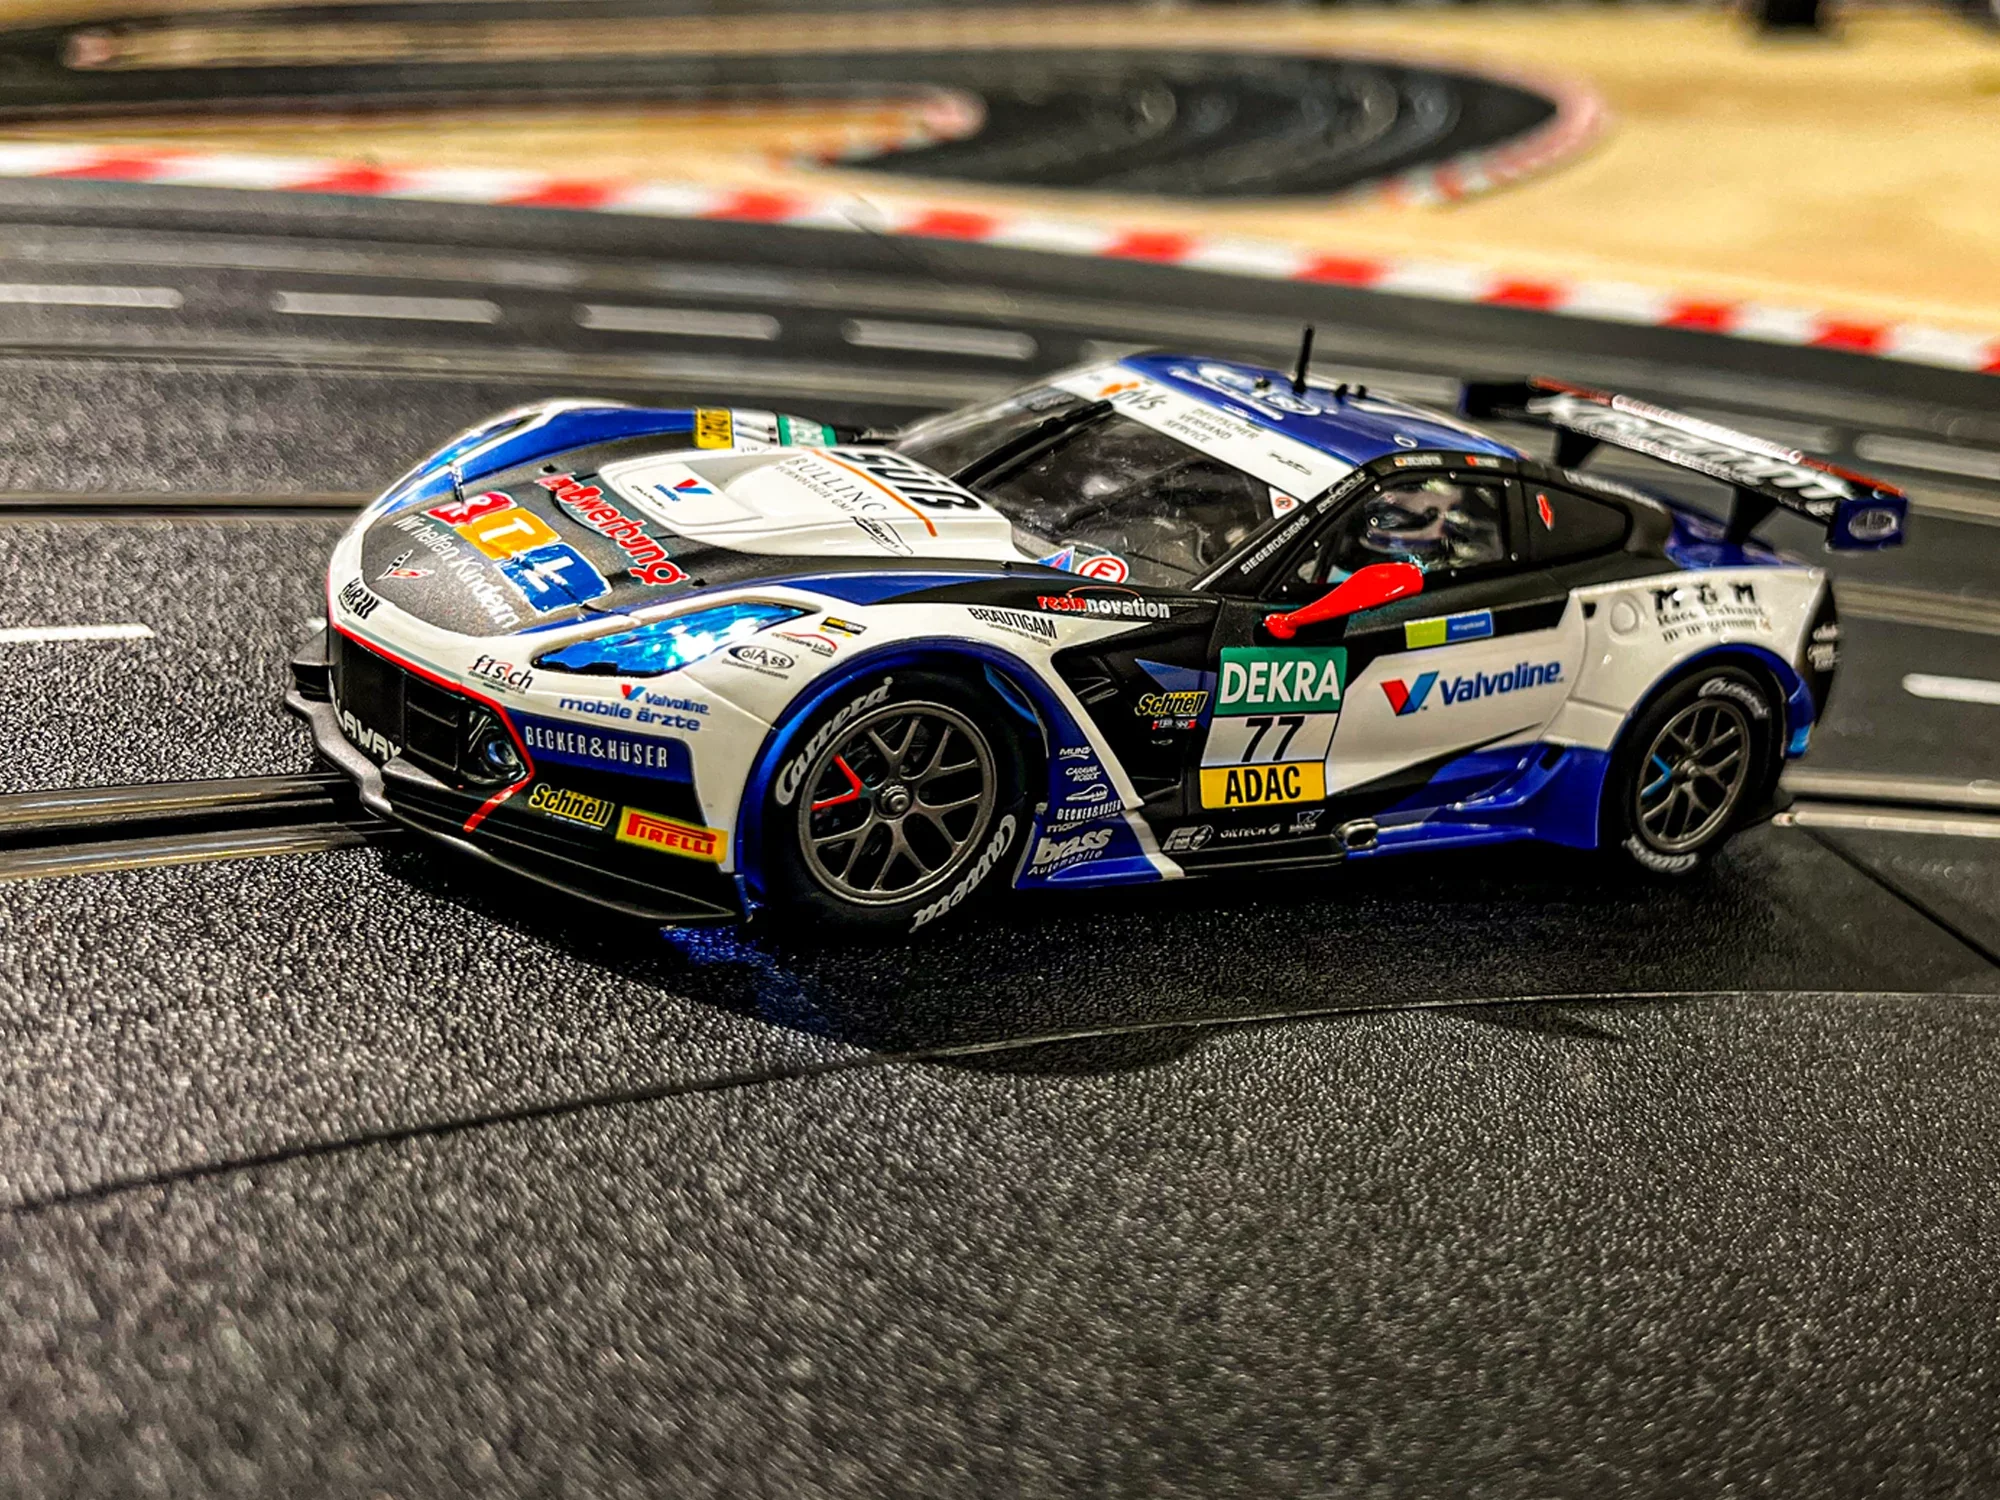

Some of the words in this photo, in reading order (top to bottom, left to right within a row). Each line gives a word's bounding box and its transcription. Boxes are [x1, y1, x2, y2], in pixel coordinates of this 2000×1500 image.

[434, 492, 582, 597] RTL
[1240, 514, 1310, 575] SIEGERDESIGNS
[410, 523, 460, 561] helfen
[450, 556, 521, 629] Kindern
[1037, 593, 1171, 619] resinnovation
[472, 654, 534, 689] f1s.ch
[1219, 660, 1341, 704] DEKRA
[1440, 661, 1562, 706] Valvoline
[559, 698, 633, 720] mobile
[636, 706, 701, 731] ärzte
[645, 691, 711, 716] Valvoline
[1134, 691, 1209, 716] Schnell
[525, 725, 669, 769] BECKER&HÜSER
[775, 676, 894, 806] Carrera
[1241, 716, 1306, 763] 77
[529, 783, 616, 827] Schnell
[1225, 766, 1301, 805] ADAC
[626, 813, 717, 855] PIRELLI
[1032, 829, 1113, 866] brass
[909, 814, 1017, 934] Carrera
[1028, 850, 1104, 876] Automobile
